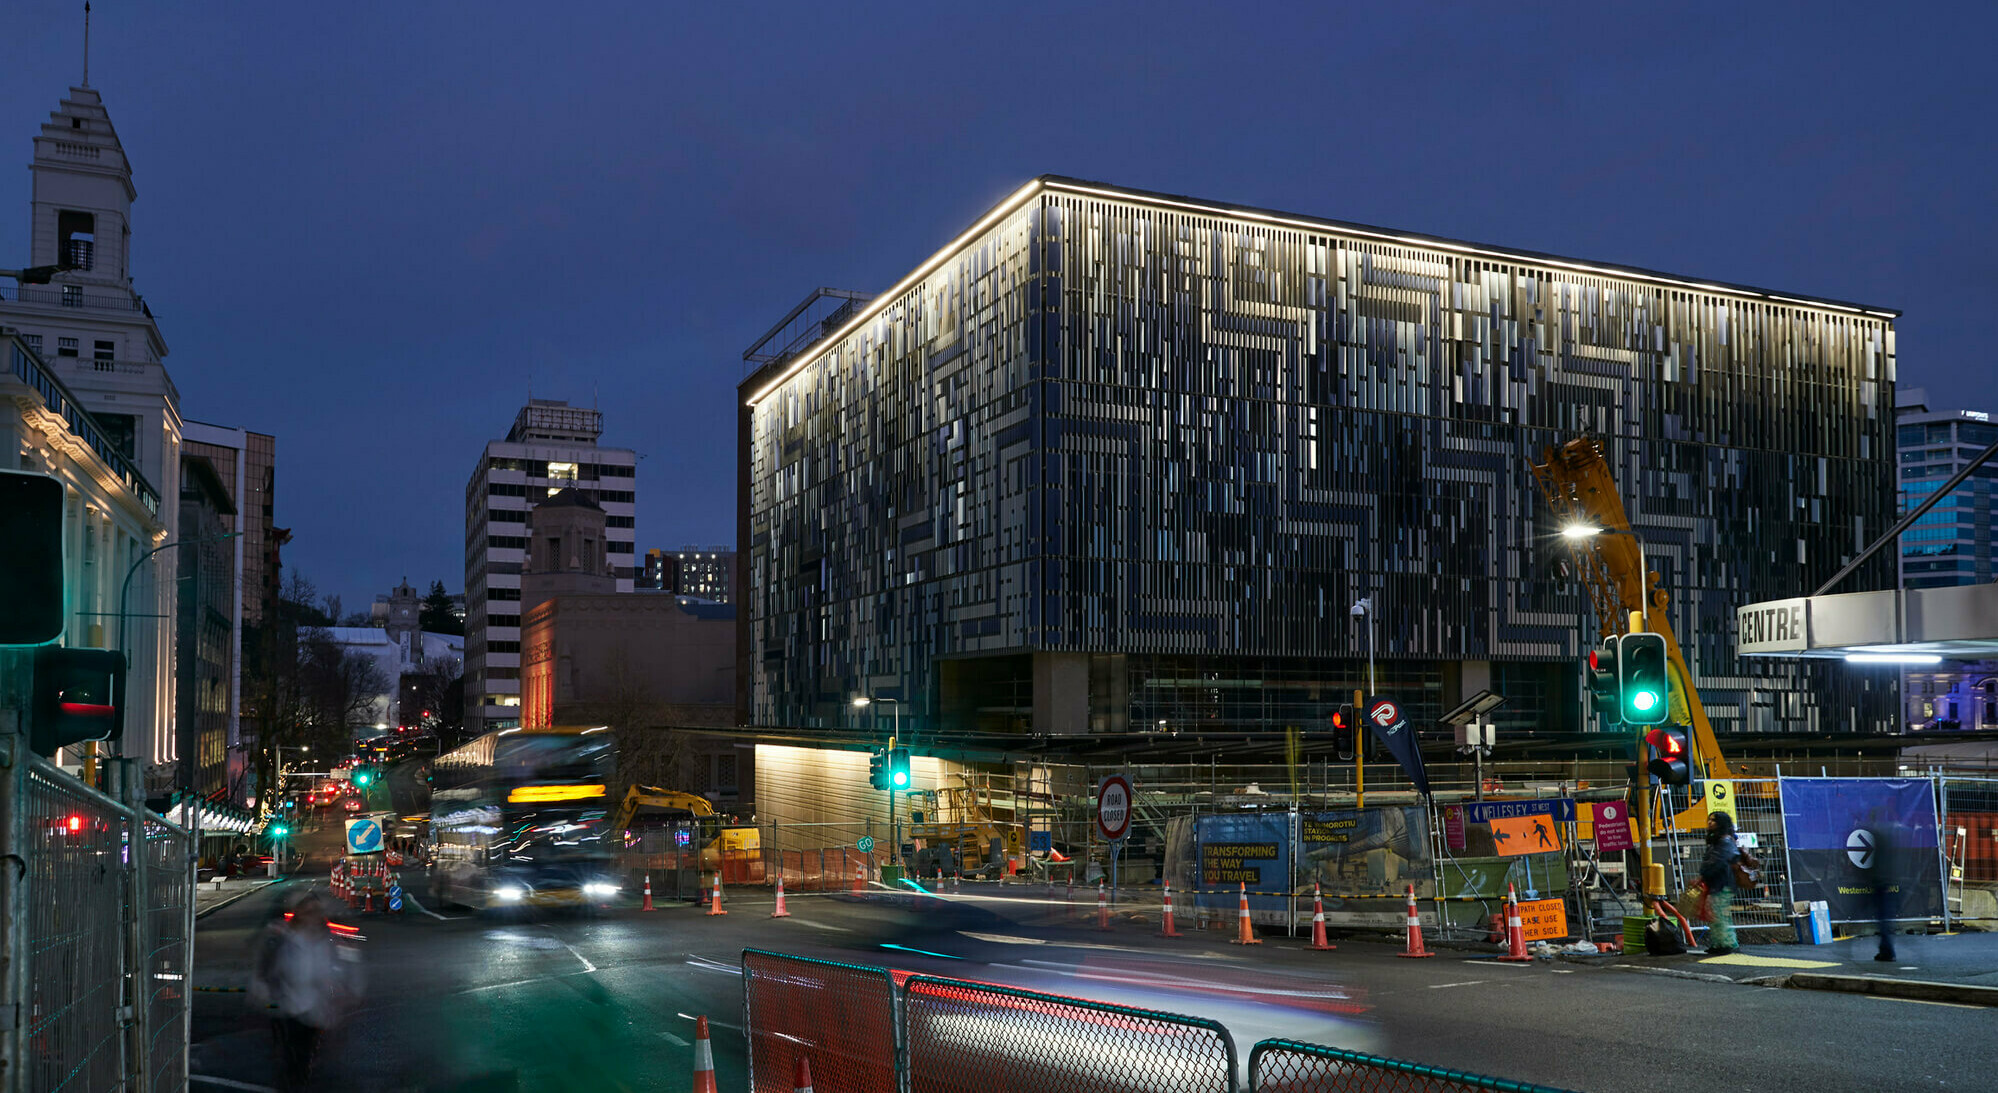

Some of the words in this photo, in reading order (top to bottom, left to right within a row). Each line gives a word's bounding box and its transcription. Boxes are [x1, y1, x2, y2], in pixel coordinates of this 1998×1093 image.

[1742, 606, 1801, 645] CENTRE
[1107, 793, 1122, 806] ROAD
[1103, 809, 1124, 821] CLOSED
[1482, 804, 1527, 820] WELLESLEY
[1531, 804, 1538, 812] ST
[1538, 803, 1550, 811] WEST
[859, 838, 872, 850] GO
[1203, 845, 1276, 857] TRANSFORMING
[1203, 857, 1218, 869] THE
[1220, 858, 1241, 869] WAY
[1203, 870, 1220, 881] YOU
[1221, 870, 1258, 882] TRAVEL
[1538, 902, 1562, 912] CLOSED
[1521, 915, 1541, 926] EASE
[1543, 914, 1559, 923] USE
[1524, 928, 1539, 937] HER
[1542, 926, 1559, 935] SIDE
